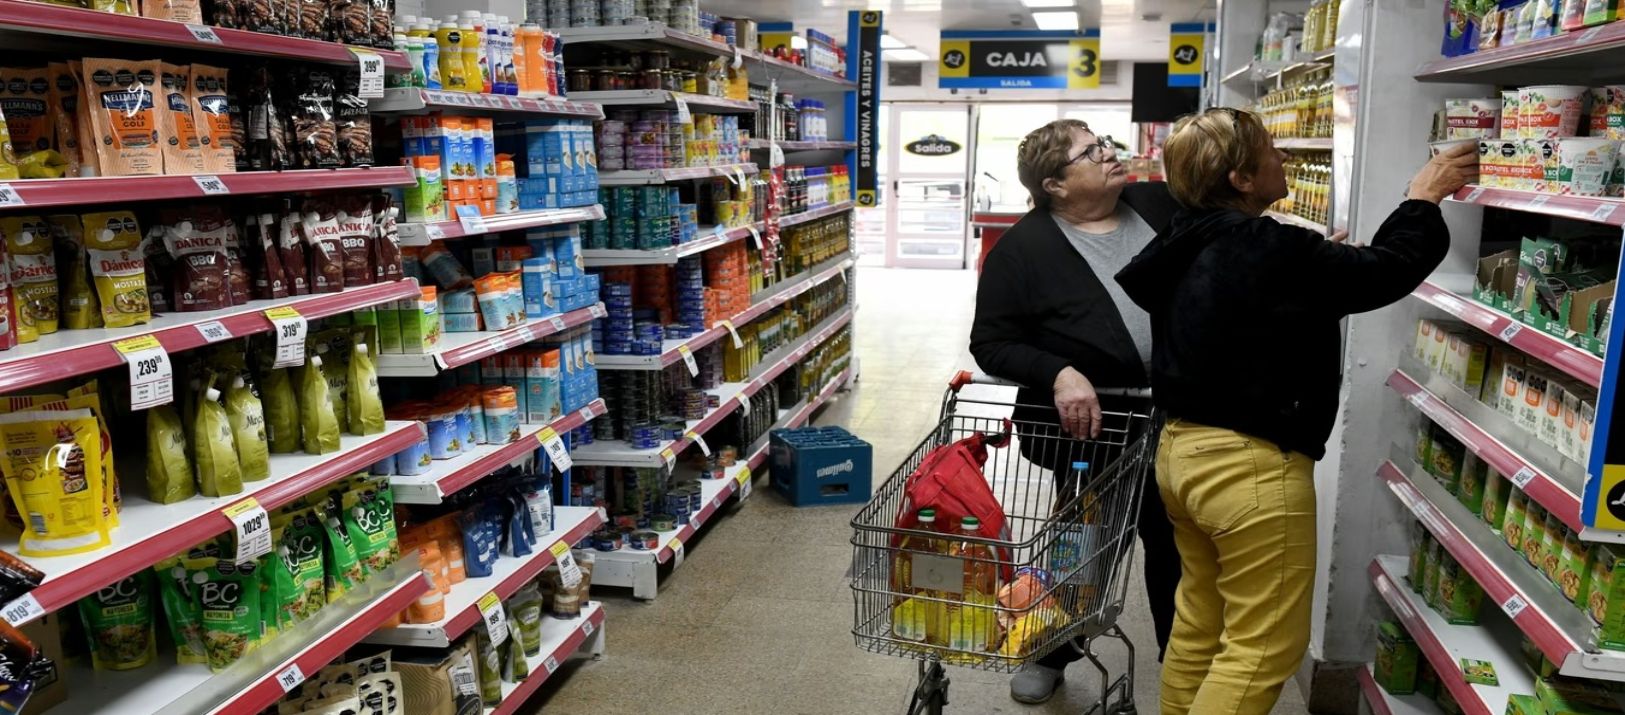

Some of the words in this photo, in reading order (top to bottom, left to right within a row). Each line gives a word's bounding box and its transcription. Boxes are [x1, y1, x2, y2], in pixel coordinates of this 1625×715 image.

[986, 52, 1047, 67] CAJA
[1073, 49, 1097, 77] 3
[861, 50, 873, 96] ACEITES
[1000, 79, 1032, 87] SALIDA
[861, 111, 871, 168] VINAGRES
[915, 143, 952, 153] Salida
[342, 238, 365, 248] BBQ
[190, 255, 215, 266] BBQ
[201, 582, 239, 604] BC
